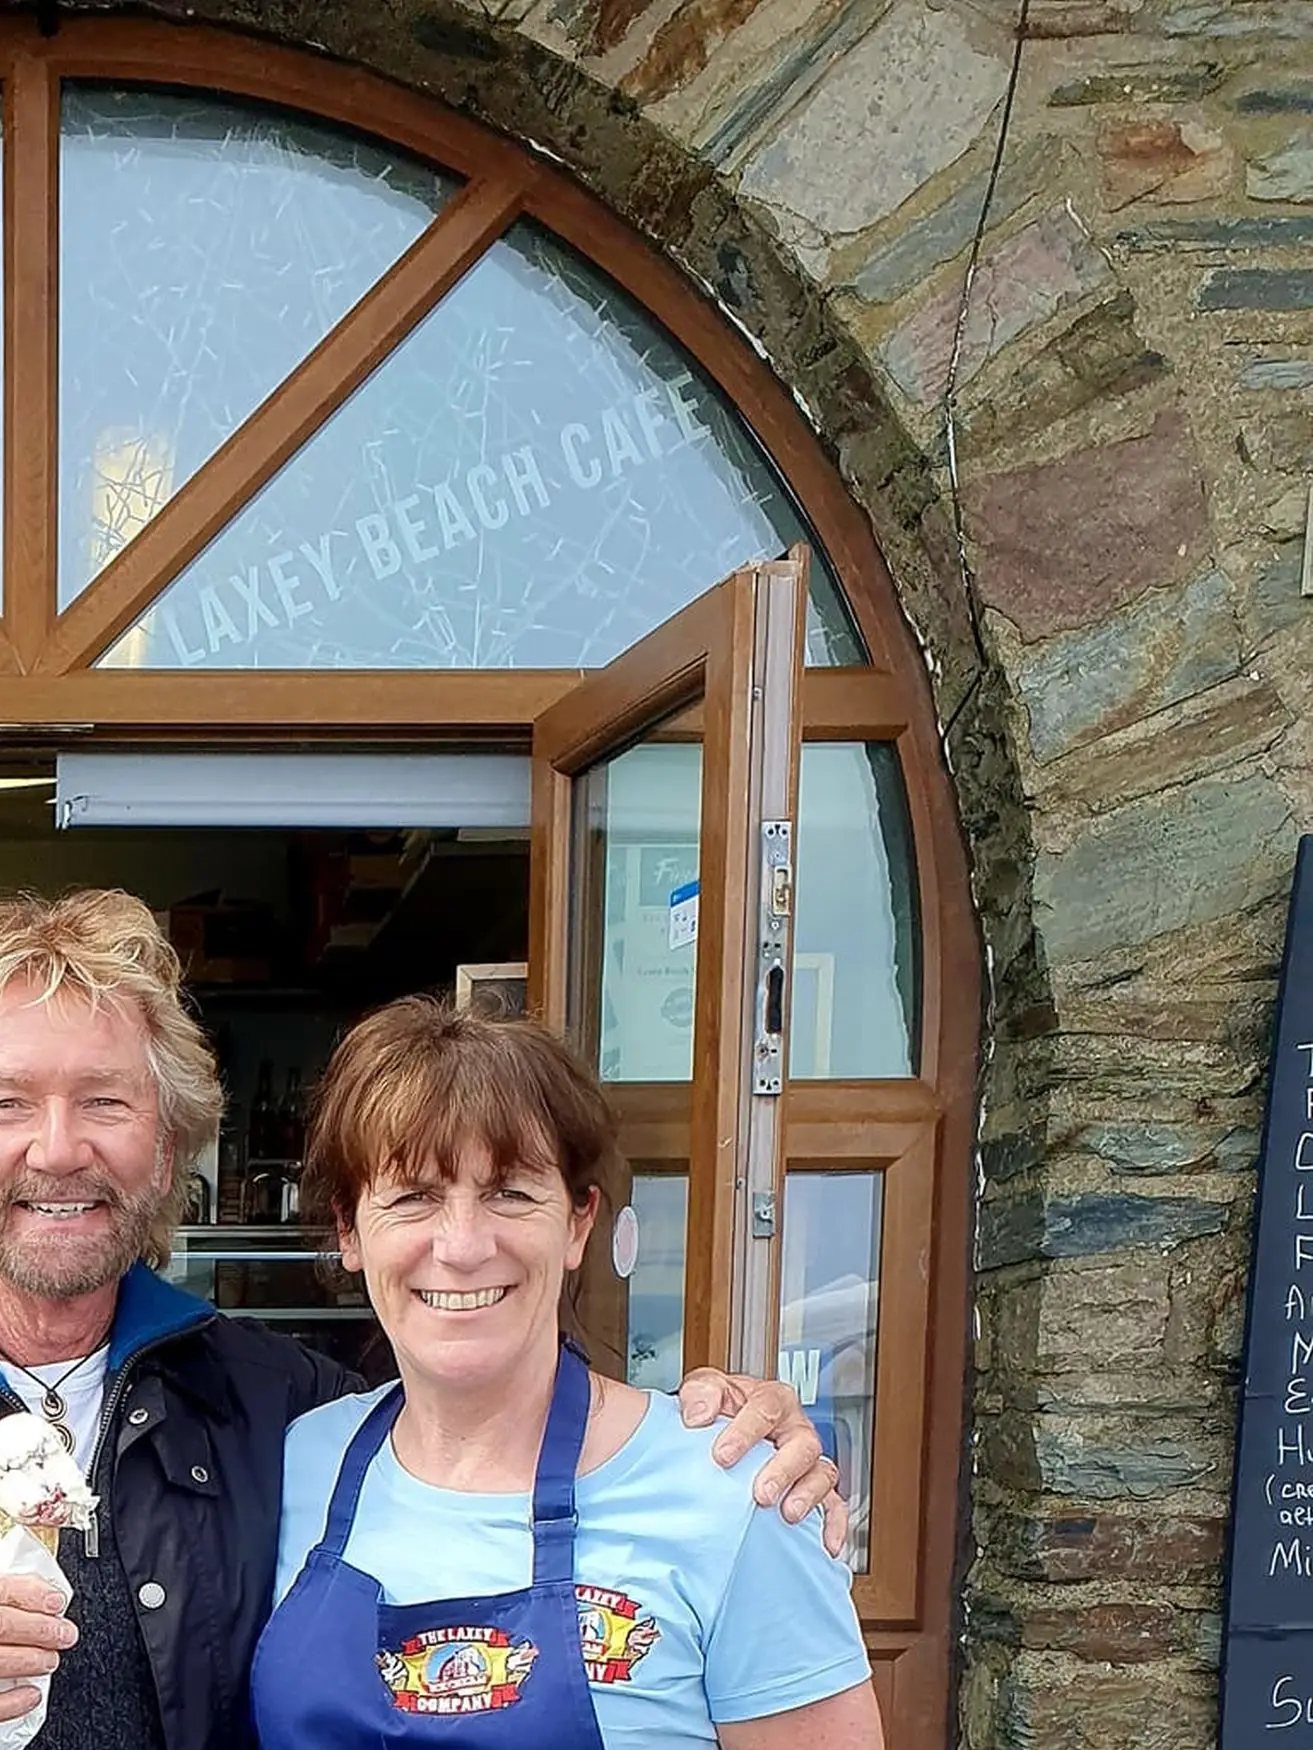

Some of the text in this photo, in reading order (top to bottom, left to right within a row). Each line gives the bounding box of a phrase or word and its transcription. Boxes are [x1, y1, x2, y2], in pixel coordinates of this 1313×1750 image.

[163, 371, 712, 666] LAXEY BEACH CAFE
[417, 1626, 494, 1645] THE LAXEY
[416, 1693, 493, 1713] COMPANY
